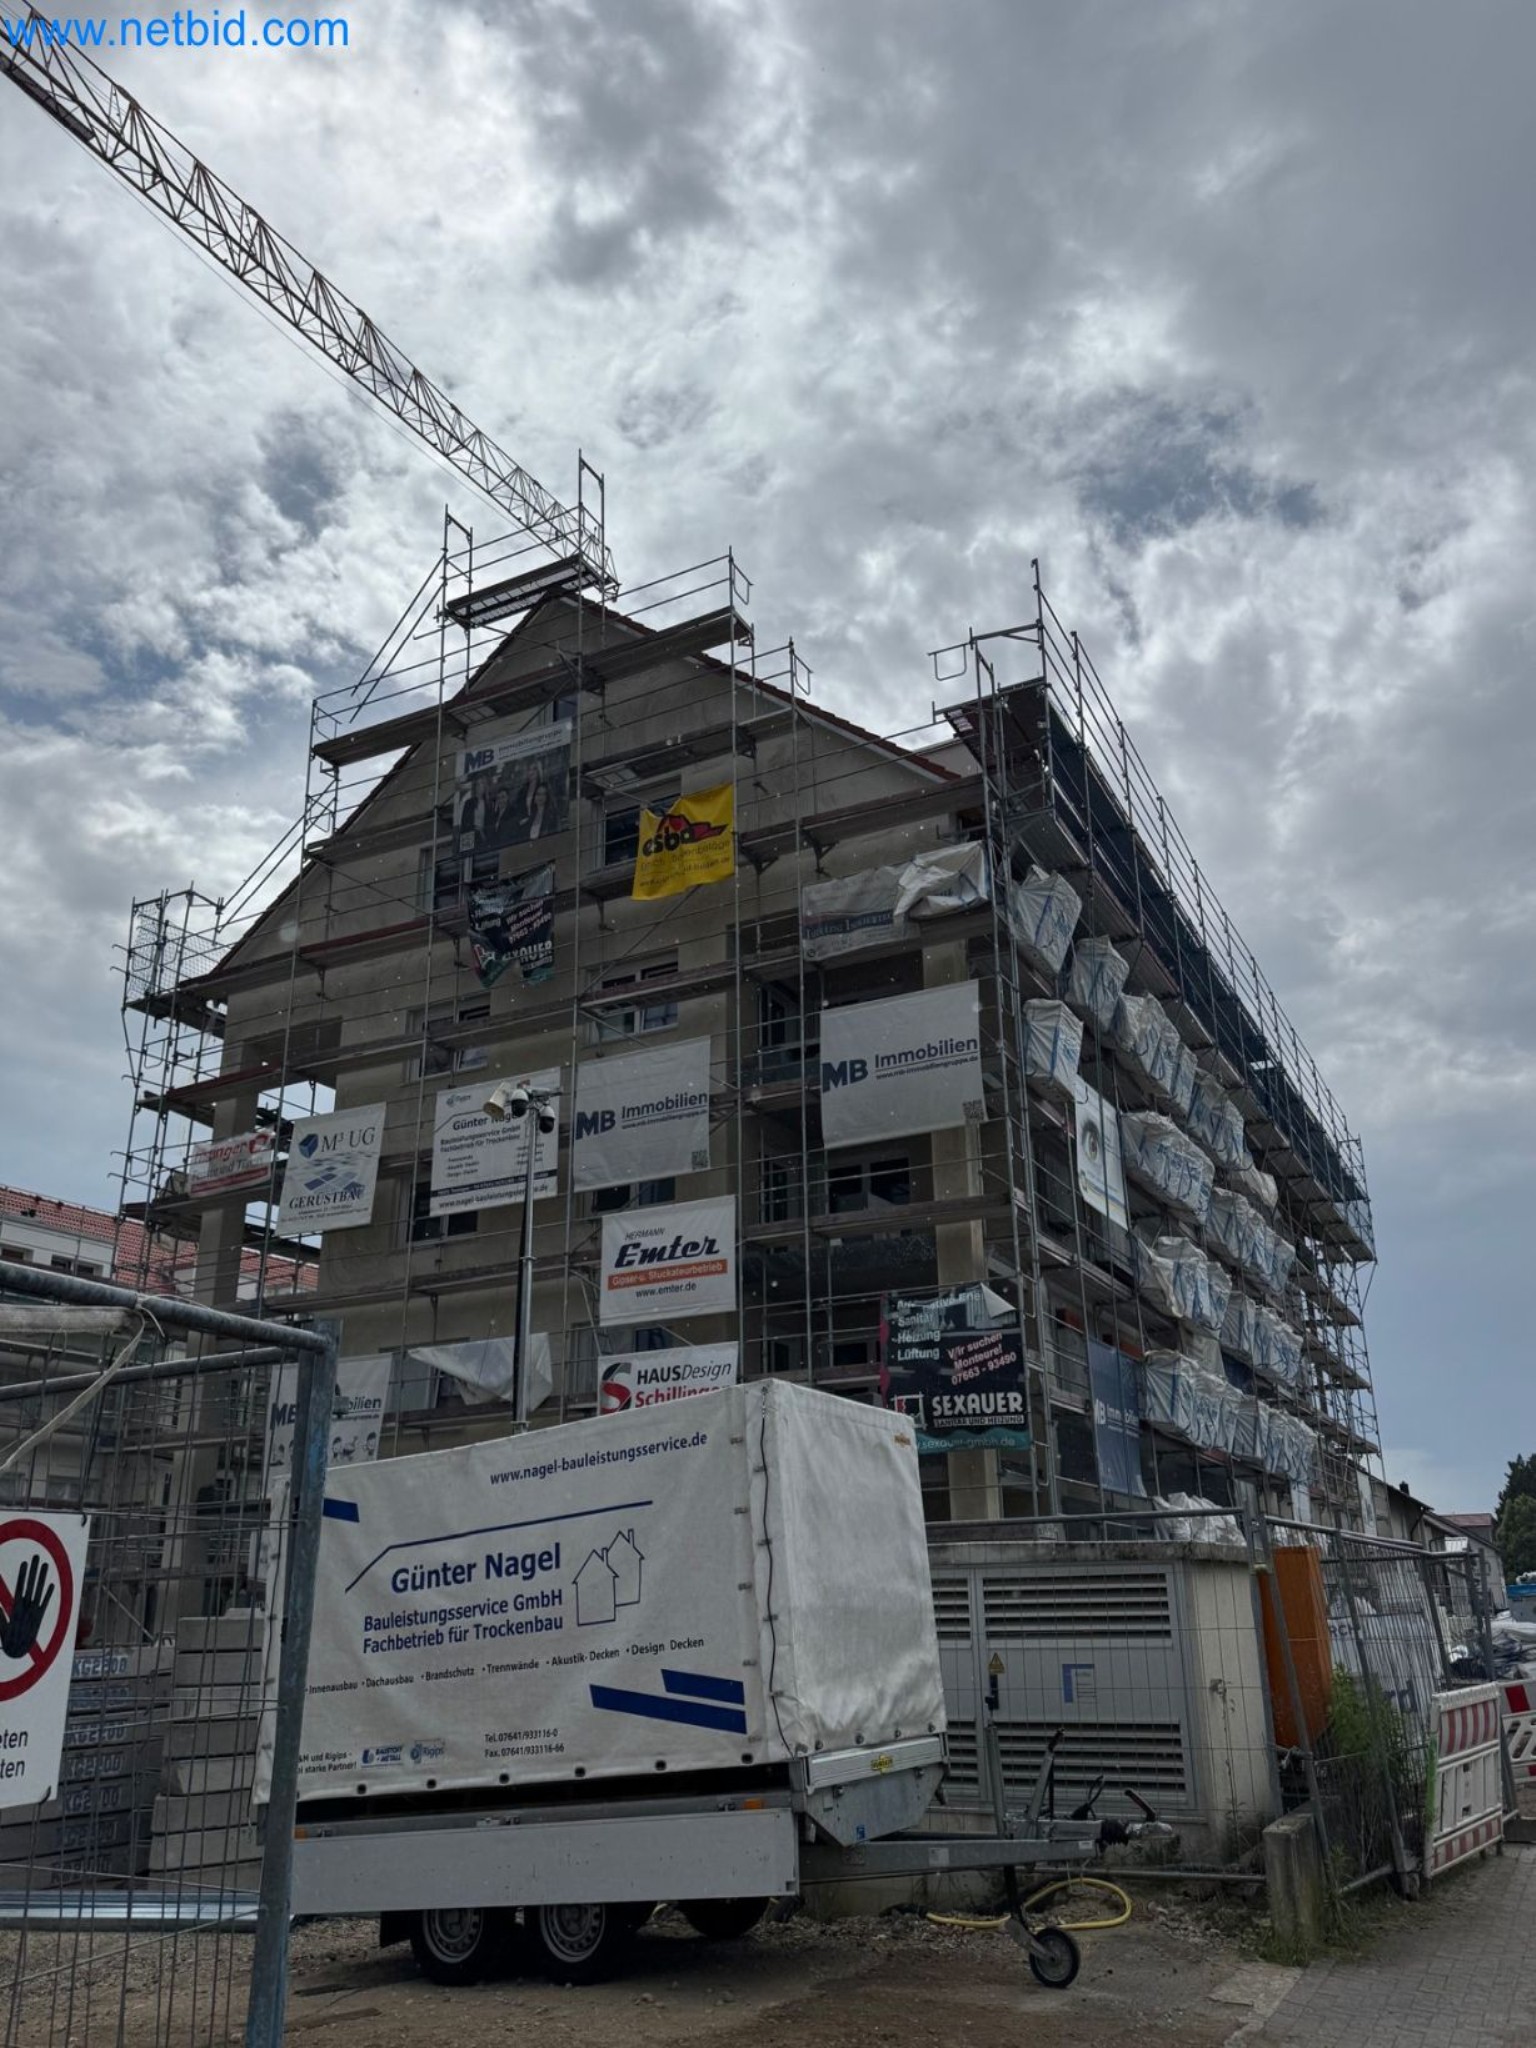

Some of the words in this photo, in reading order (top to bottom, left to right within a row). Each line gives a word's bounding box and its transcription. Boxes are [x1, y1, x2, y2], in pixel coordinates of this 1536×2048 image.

[465, 749, 494, 774] MB
[822, 1060, 868, 1093] MB
[875, 1038, 978, 1068] Immobilien
[453, 1117, 488, 1130] Günter
[576, 1111, 616, 1140] MB
[622, 1092, 707, 1119] Immobilien
[350, 1127, 375, 1147] UG
[614, 1235, 720, 1268] Emter
[636, 1281, 697, 1297] www.emter.de
[898, 1347, 940, 1361] Lüftung
[946, 1345, 965, 1360] Wir
[967, 1332, 1003, 1352] suchen
[637, 1360, 731, 1386] HAUSDesign
[932, 1391, 1023, 1417] SEXAUER
[490, 1432, 707, 1485] www.nagel-bauleistungsservice.de
[392, 1562, 477, 1593] Günter
[485, 1542, 561, 1581] Nagel
[364, 1598, 508, 1632] Bauleistungsservice
[513, 1589, 562, 1611] GmbH
[363, 1629, 444, 1653] Fachbetrieb
[448, 1626, 469, 1643] für
[474, 1616, 563, 1640] Trockenbau
[366, 1674, 414, 1688] Dachausbau
[425, 1666, 475, 1681] Brandschutz
[487, 1660, 540, 1673] Trennwände
[590, 1647, 620, 1661] Decken
[631, 1642, 665, 1656] Design
[670, 1636, 704, 1650] Decken
